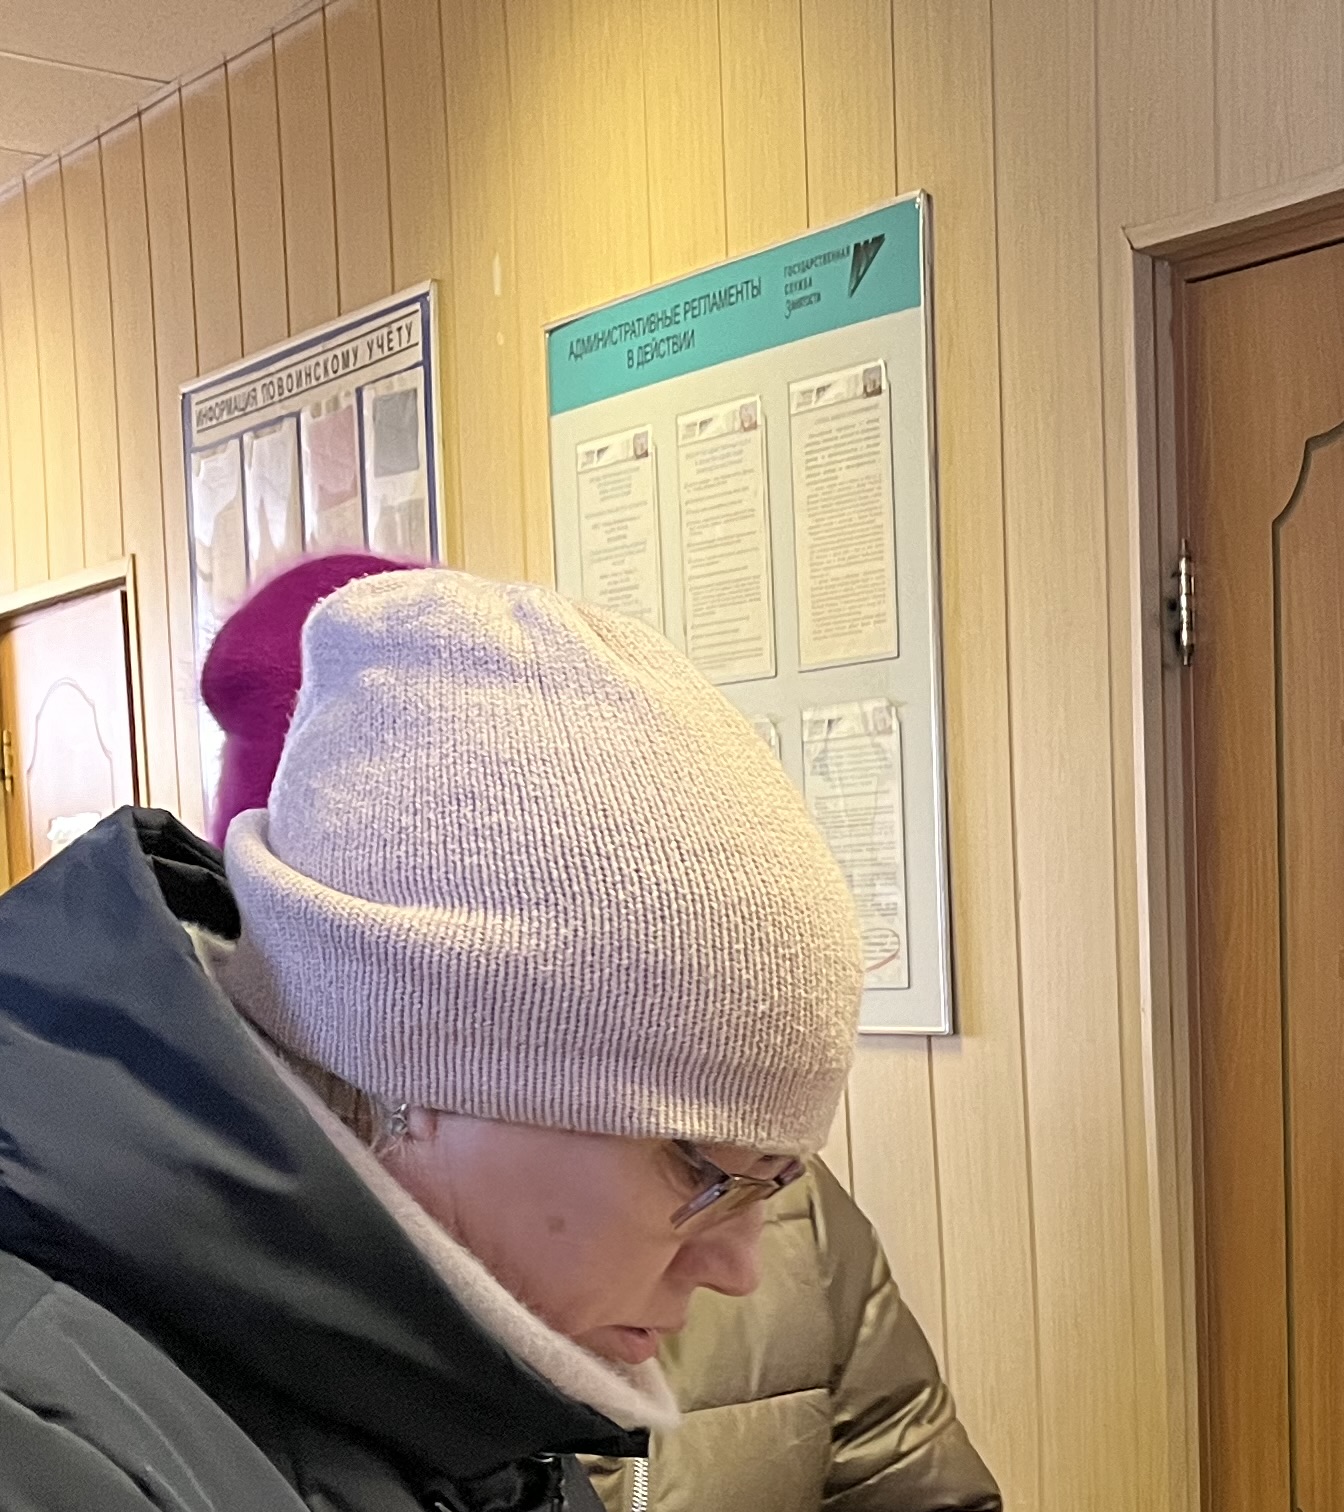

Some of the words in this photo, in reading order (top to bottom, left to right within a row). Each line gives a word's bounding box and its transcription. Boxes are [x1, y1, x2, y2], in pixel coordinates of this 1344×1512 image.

[568, 304, 681, 362] АДМИНИСТРАТИВНЫЕ
[683, 277, 762, 321] РЕГЛАМЕНТЫ
[627, 350, 634, 369] В
[637, 329, 695, 368] ДЕЙСТВИИ
